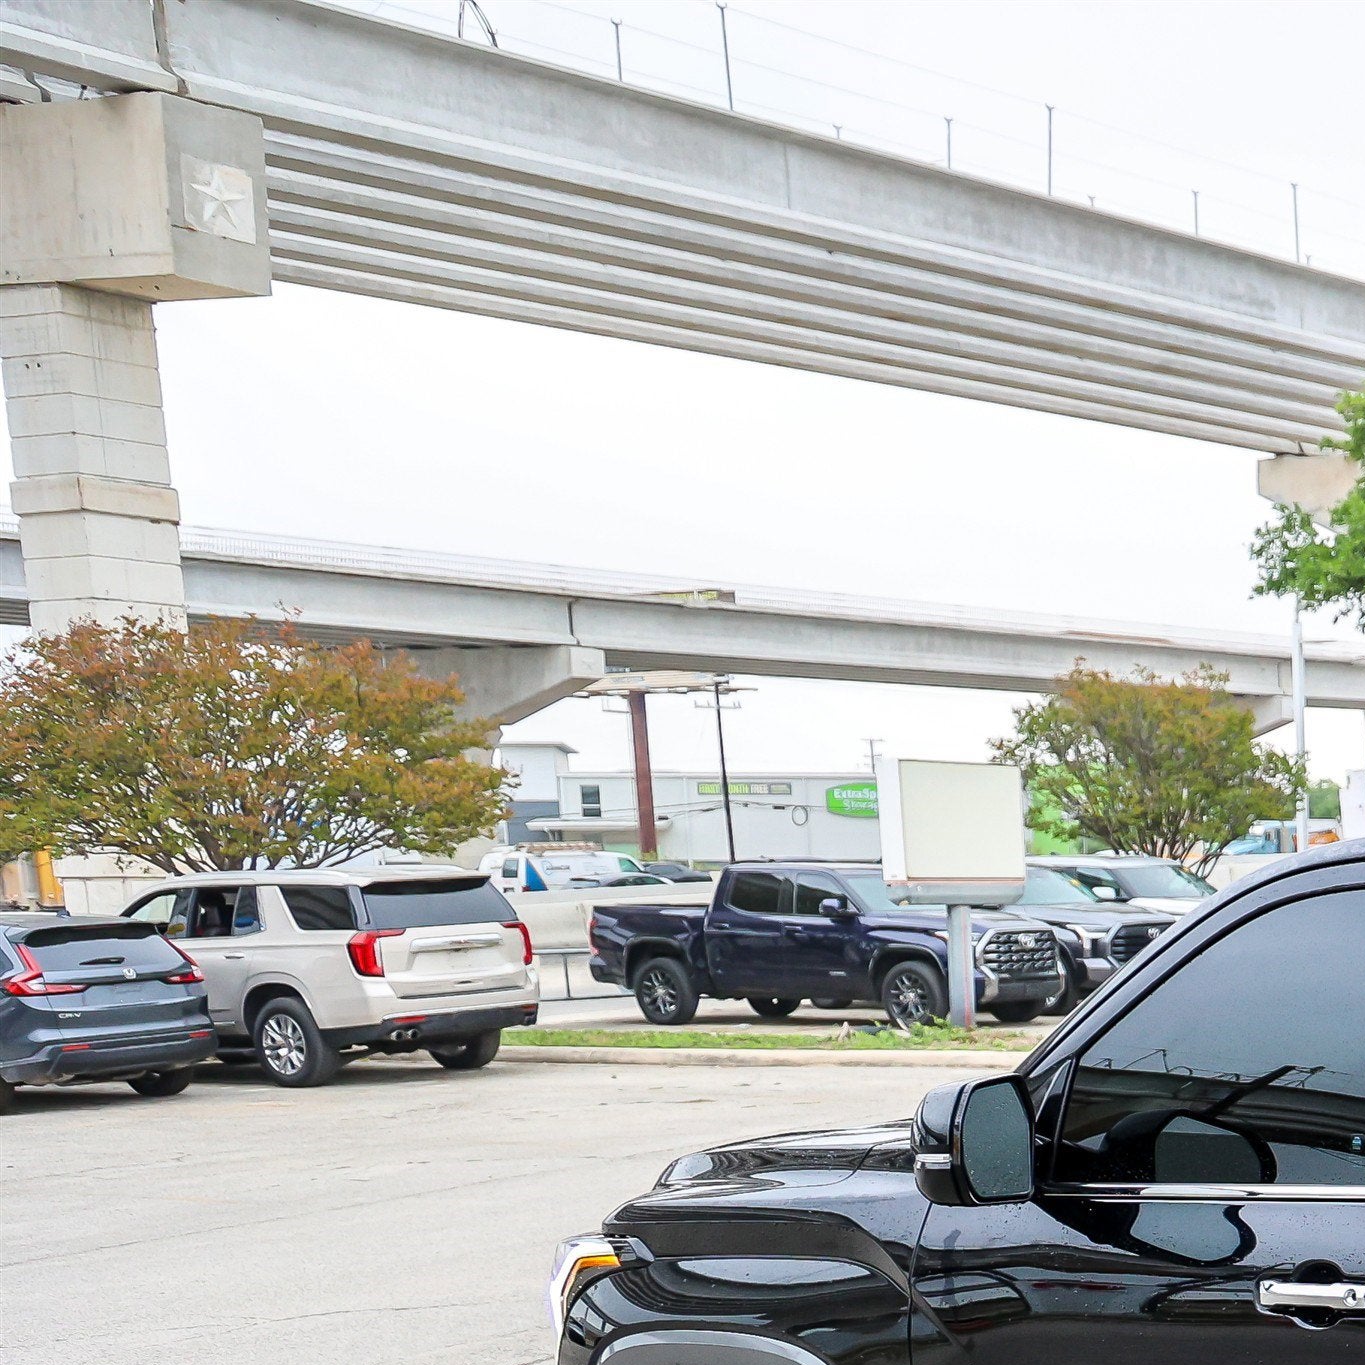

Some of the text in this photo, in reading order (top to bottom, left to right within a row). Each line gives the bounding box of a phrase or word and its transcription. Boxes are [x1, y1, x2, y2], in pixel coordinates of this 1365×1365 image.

[722, 783, 750, 794] ONTH
[751, 784, 769, 794] FREE
[833, 788, 877, 799] ExtraSp
[842, 799, 878, 811] Storag
